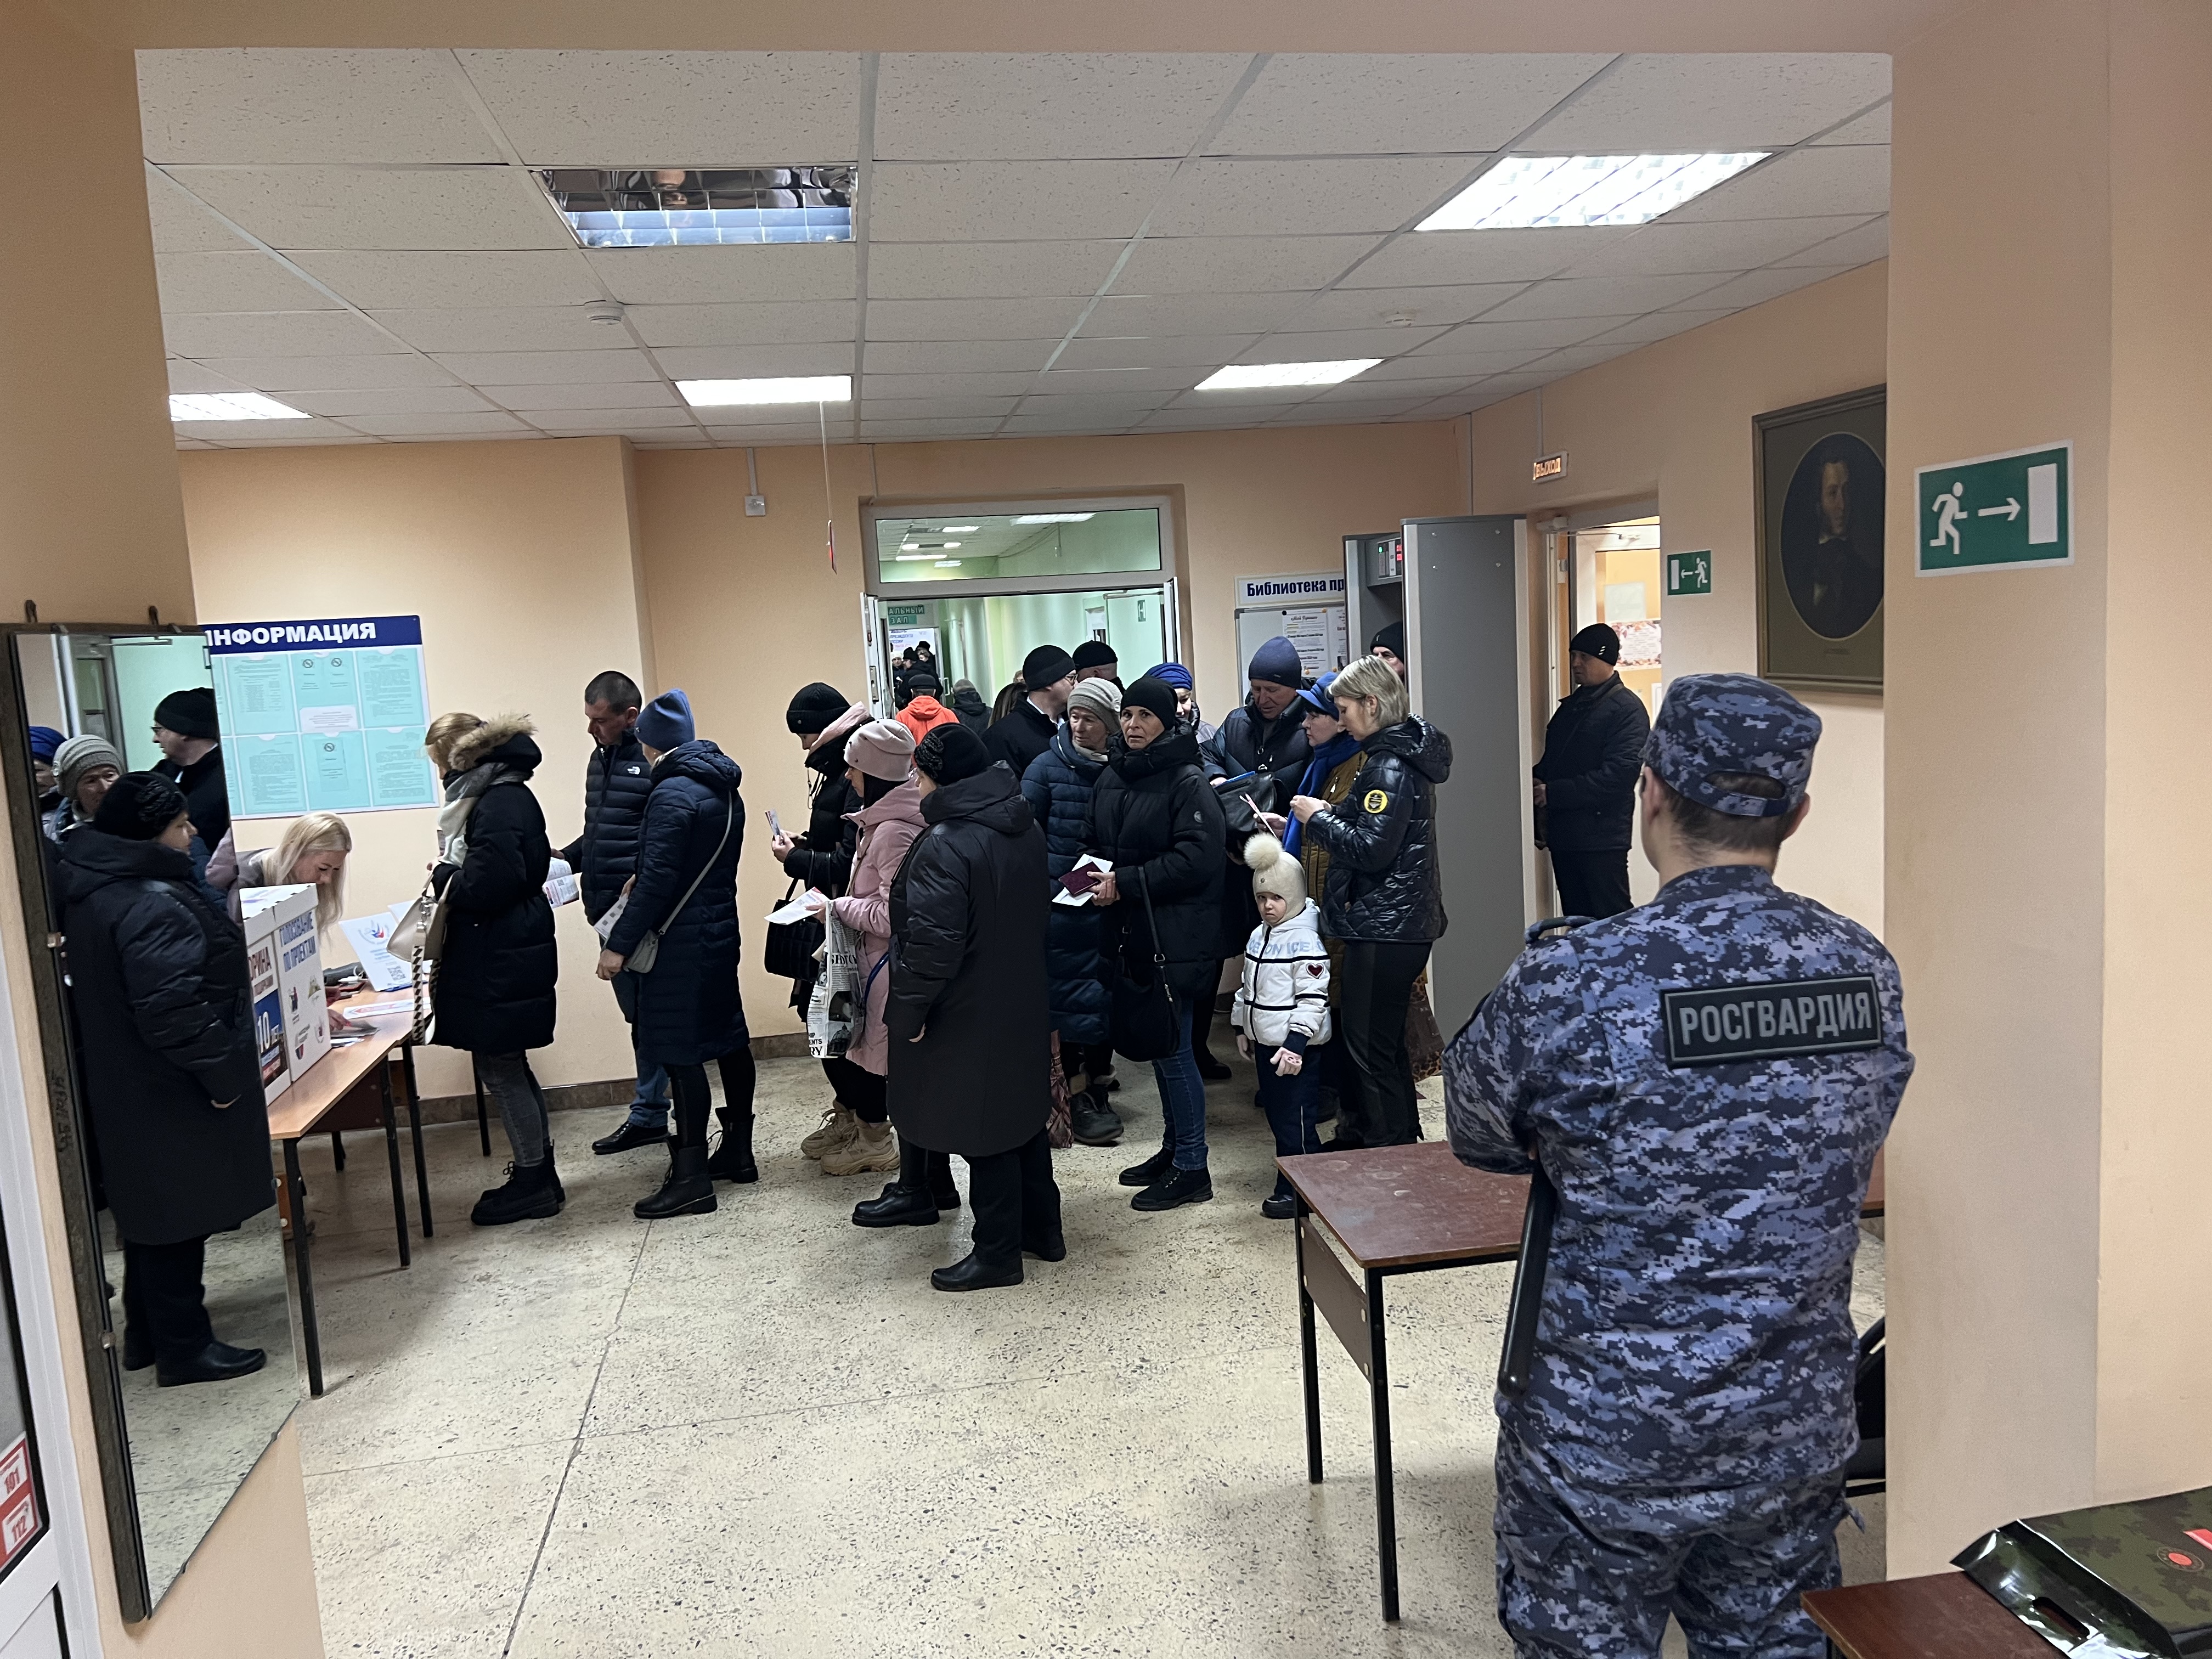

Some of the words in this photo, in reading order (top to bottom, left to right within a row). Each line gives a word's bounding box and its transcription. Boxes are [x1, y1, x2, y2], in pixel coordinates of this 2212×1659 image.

[1247, 580, 1326, 596] Библиотека
[889, 606, 923, 614] АЛЬНЫЙ
[1265, 943, 1284, 955] ON
[1286, 941, 1311, 954] ICE
[1679, 992, 1872, 1045] РОСГВАРДИЯ
